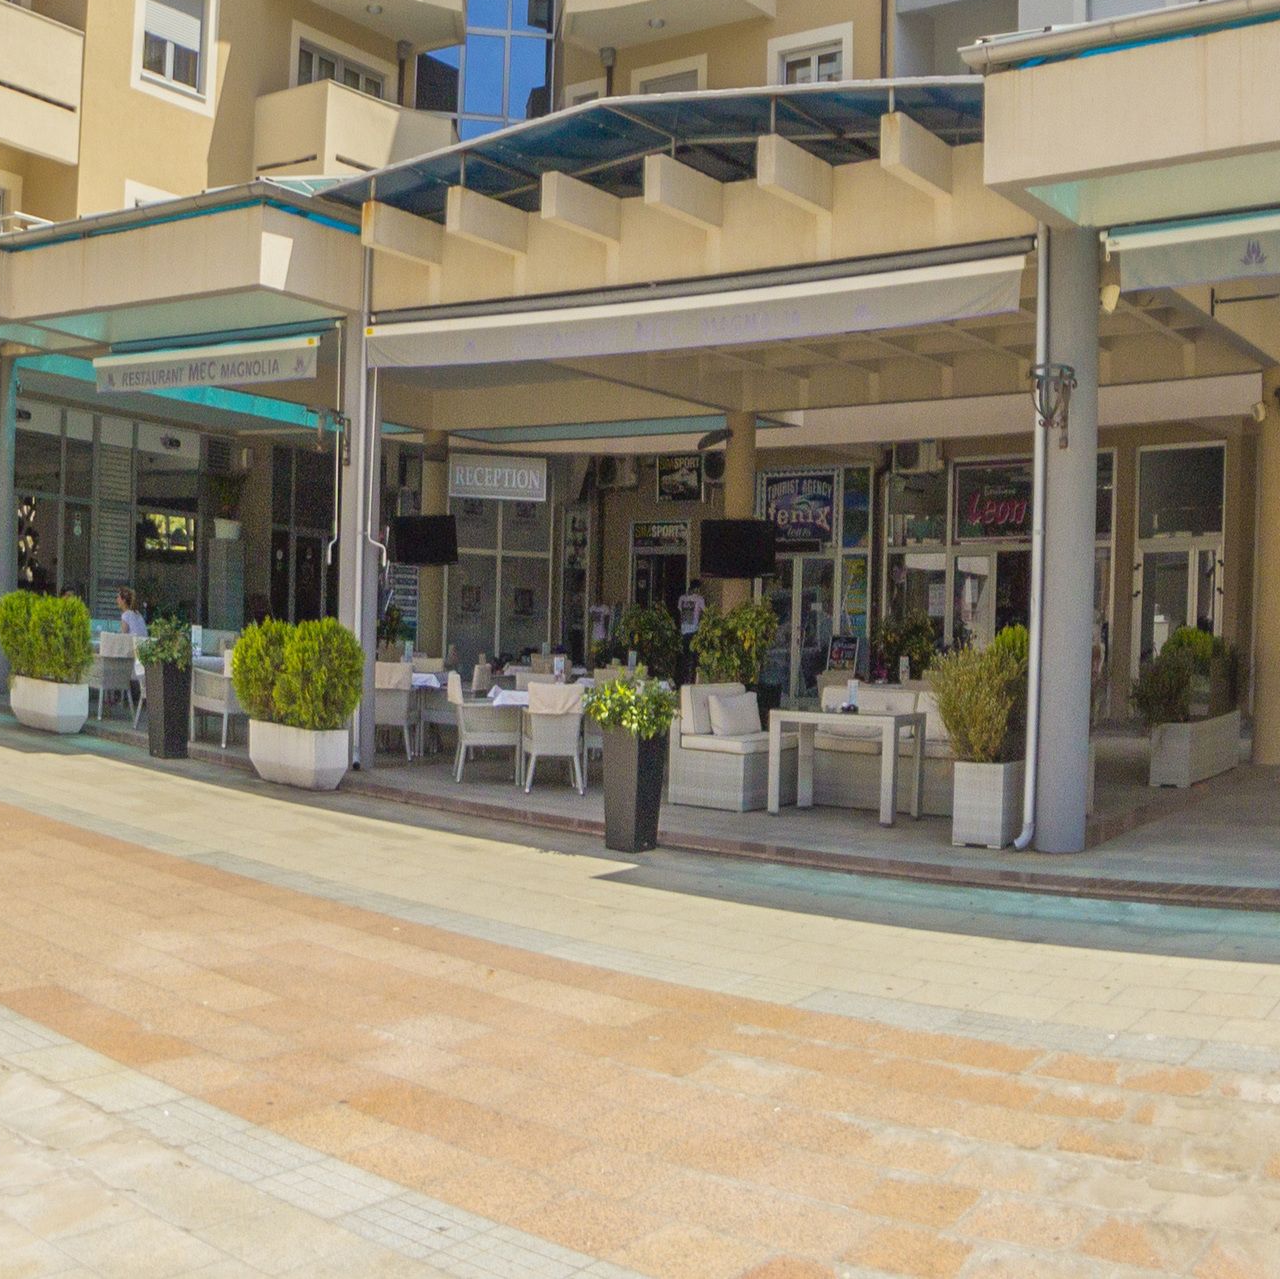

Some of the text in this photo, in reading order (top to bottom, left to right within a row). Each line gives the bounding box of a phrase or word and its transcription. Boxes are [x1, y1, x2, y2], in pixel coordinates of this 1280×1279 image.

[122, 358, 279, 388] RESTAURANT MEC MAGNOLIA
[455, 465, 540, 489] RECEPTION
[768, 478, 832, 503] TOURIST AGENCY
[966, 488, 1028, 525] Leon
